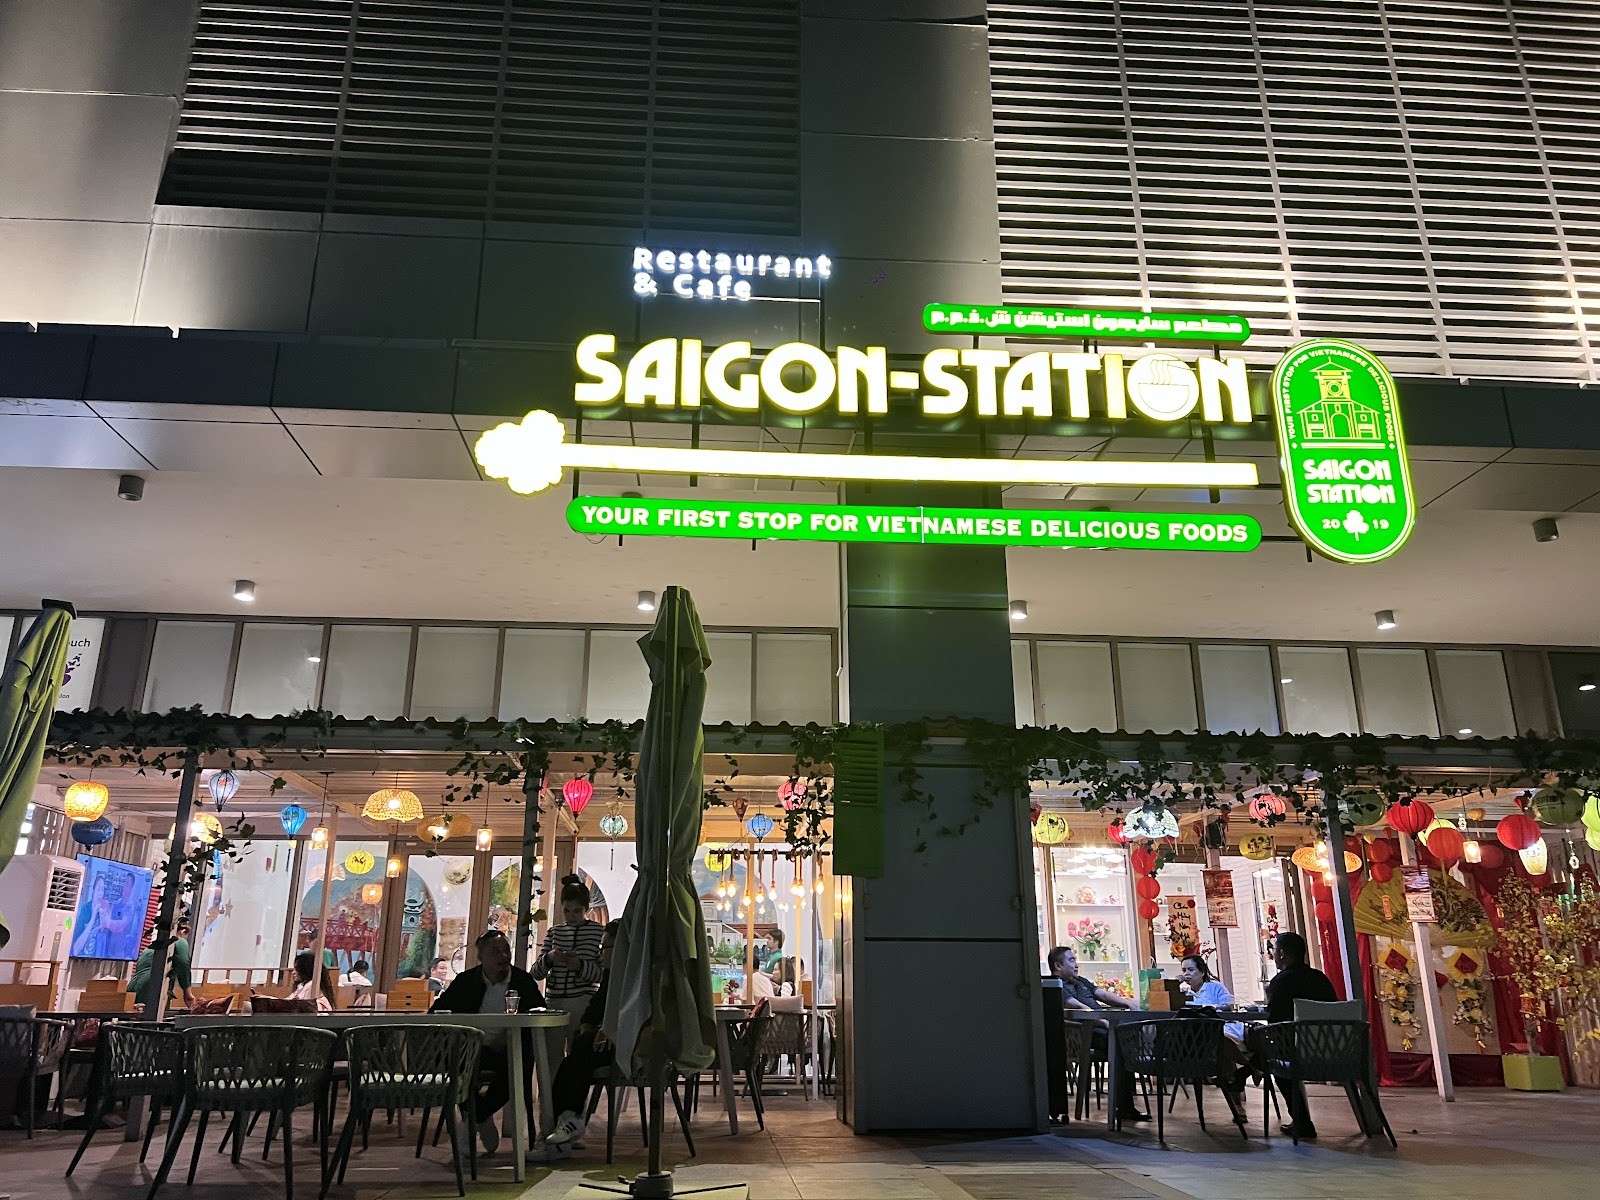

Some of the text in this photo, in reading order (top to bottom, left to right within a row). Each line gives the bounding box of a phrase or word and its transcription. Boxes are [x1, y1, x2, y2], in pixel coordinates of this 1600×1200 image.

[633, 247, 832, 278] Restaurant
[633, 271, 751, 300] & Cafe
[1173, 318, 1243, 333] مطعم
[1309, 348, 1368, 367] VIETNAMESE
[1282, 365, 1295, 388] STOP
[1366, 366, 1390, 412] DELICIOUS
[1283, 388, 1292, 414] FIRST
[1286, 416, 1297, 439] YOUR
[1385, 413, 1395, 442] FOODS
[1302, 459, 1392, 481] SAIGON
[1306, 484, 1396, 504] STATION
[581, 505, 1248, 543] YOUR FIRST STOP FOR VIETNAMESE DELICIOUS FOODS
[1321, 519, 1390, 530] 20 19
[69, 638, 91, 648] uch
